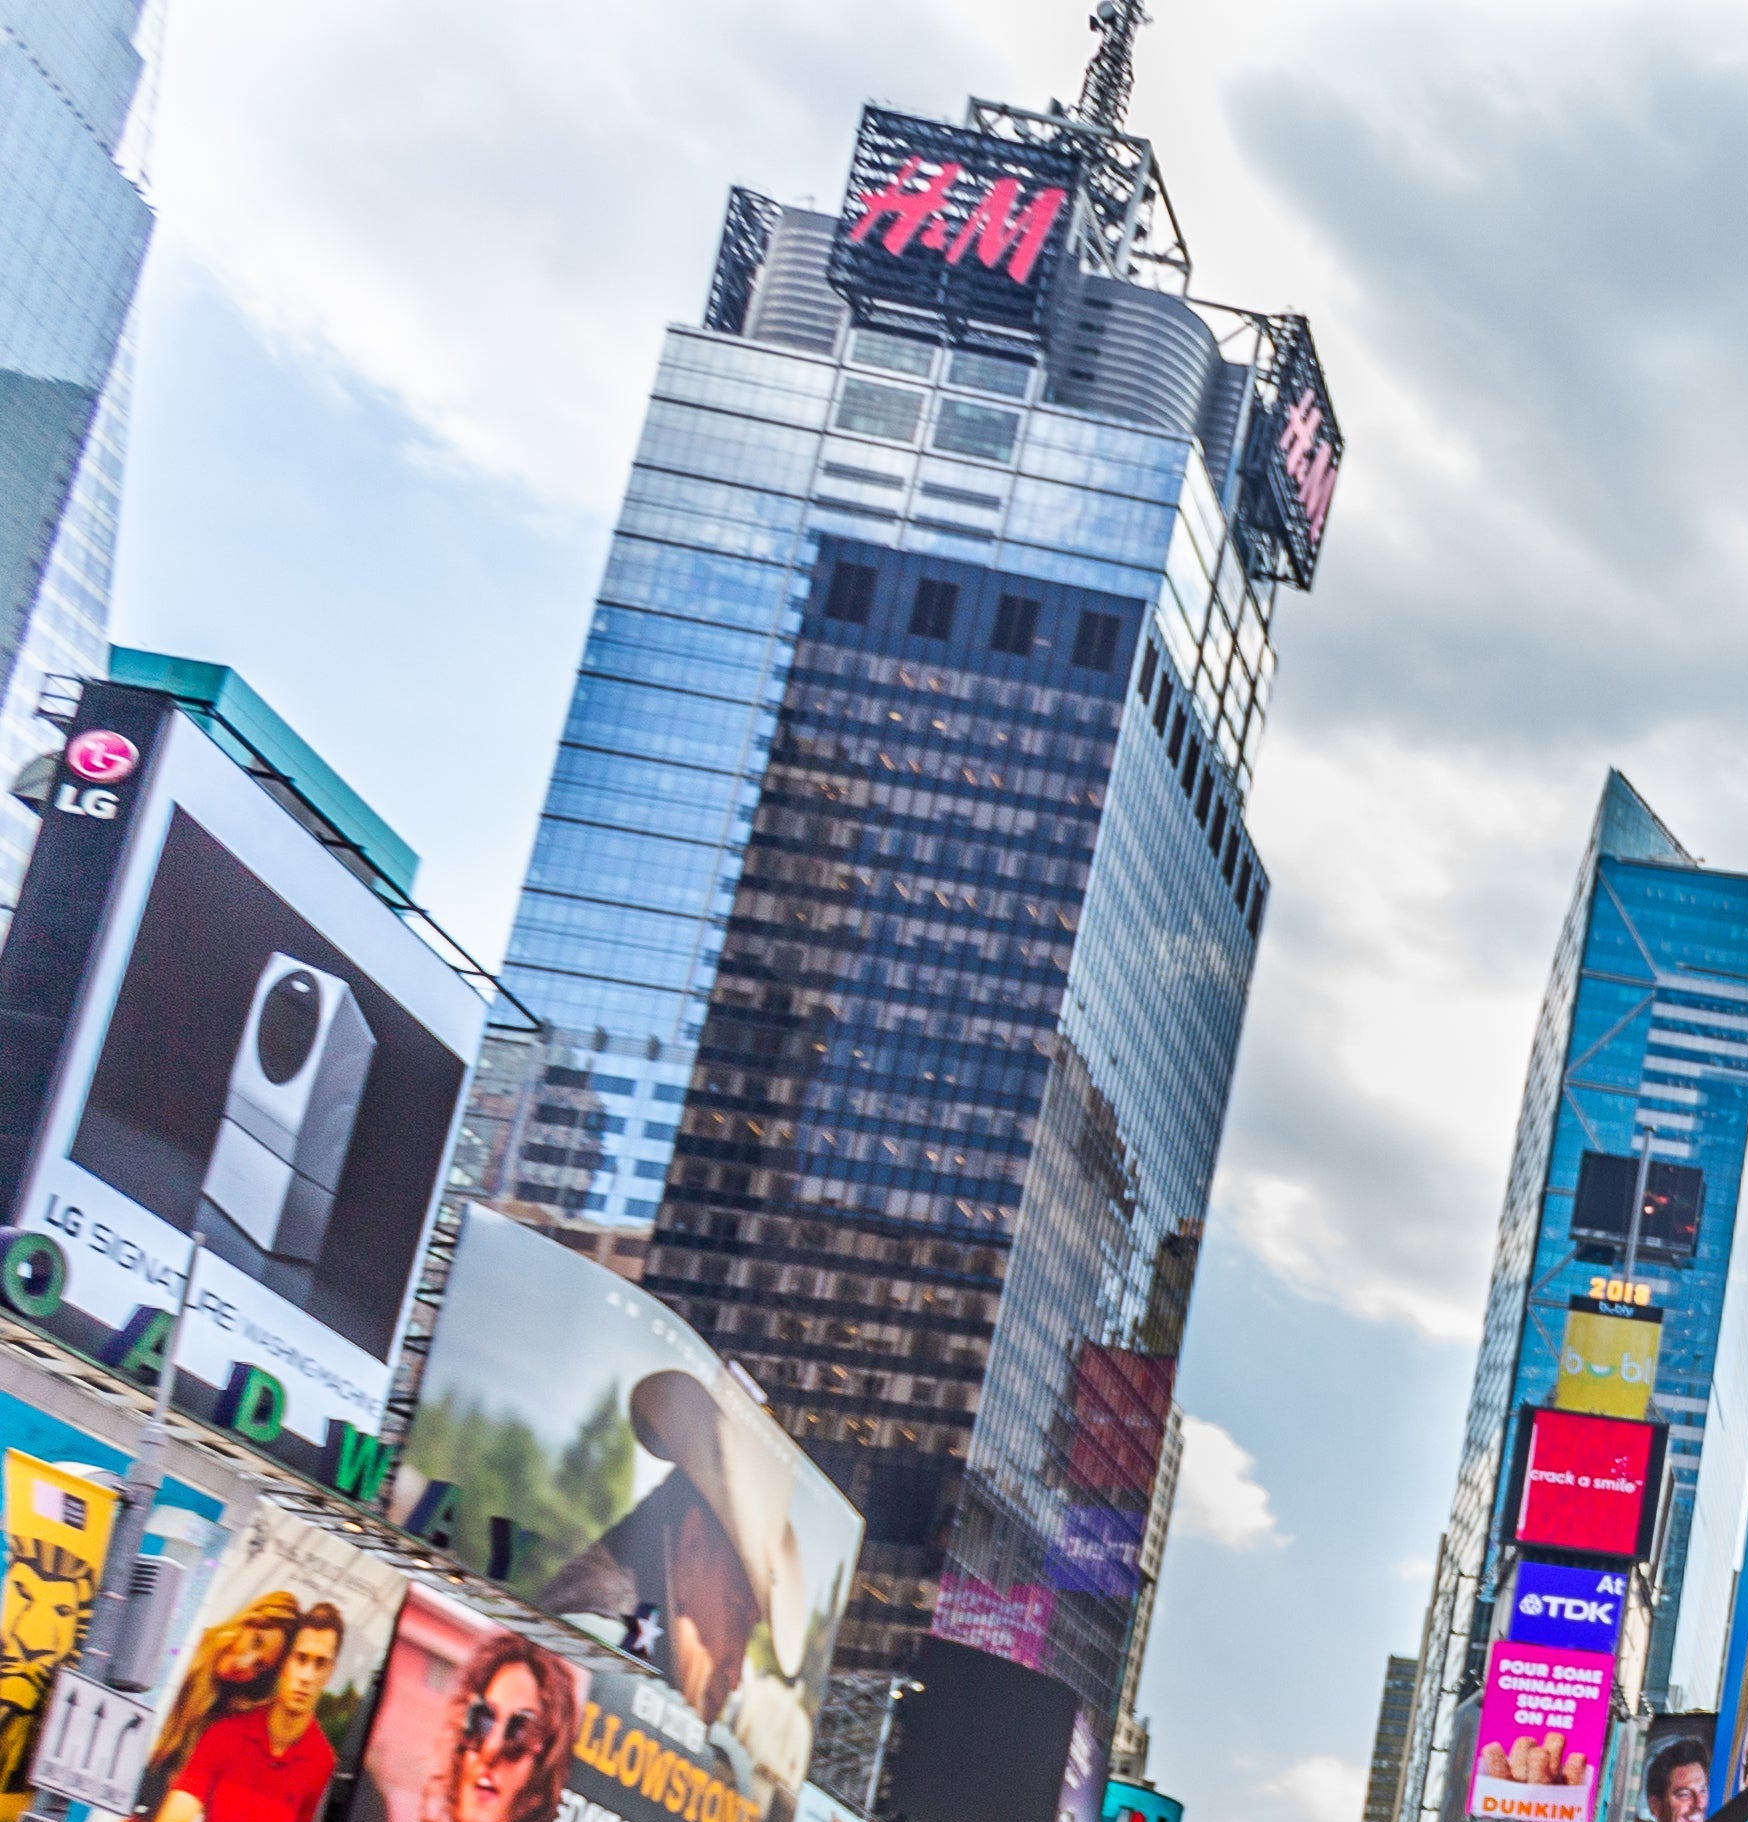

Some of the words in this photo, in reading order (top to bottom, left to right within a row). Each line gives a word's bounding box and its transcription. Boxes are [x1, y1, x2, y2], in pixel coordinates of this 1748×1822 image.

[850, 156, 1067, 283] H&M
[1280, 388, 1337, 541] H&M
[56, 783, 118, 820] LG
[45, 1194, 83, 1237] LG
[87, 1222, 238, 1332] SIGNATRE
[1590, 1277, 1651, 1305] 2018
[1530, 1468, 1575, 1487] crack
[1578, 1476, 1590, 1488] a
[1597, 1576, 1626, 1596] At
[1543, 1595, 1614, 1625] TDK
[1499, 1658, 1549, 1679] POUR
[1552, 1665, 1603, 1685] SOME
[1498, 1676, 1599, 1700] CINNAMON
[1516, 1694, 1577, 1714] SUGAR
[1514, 1709, 1543, 1726] ON
[1546, 1712, 1573, 1729] ME
[1482, 1796, 1582, 1821] DUNKIN'
